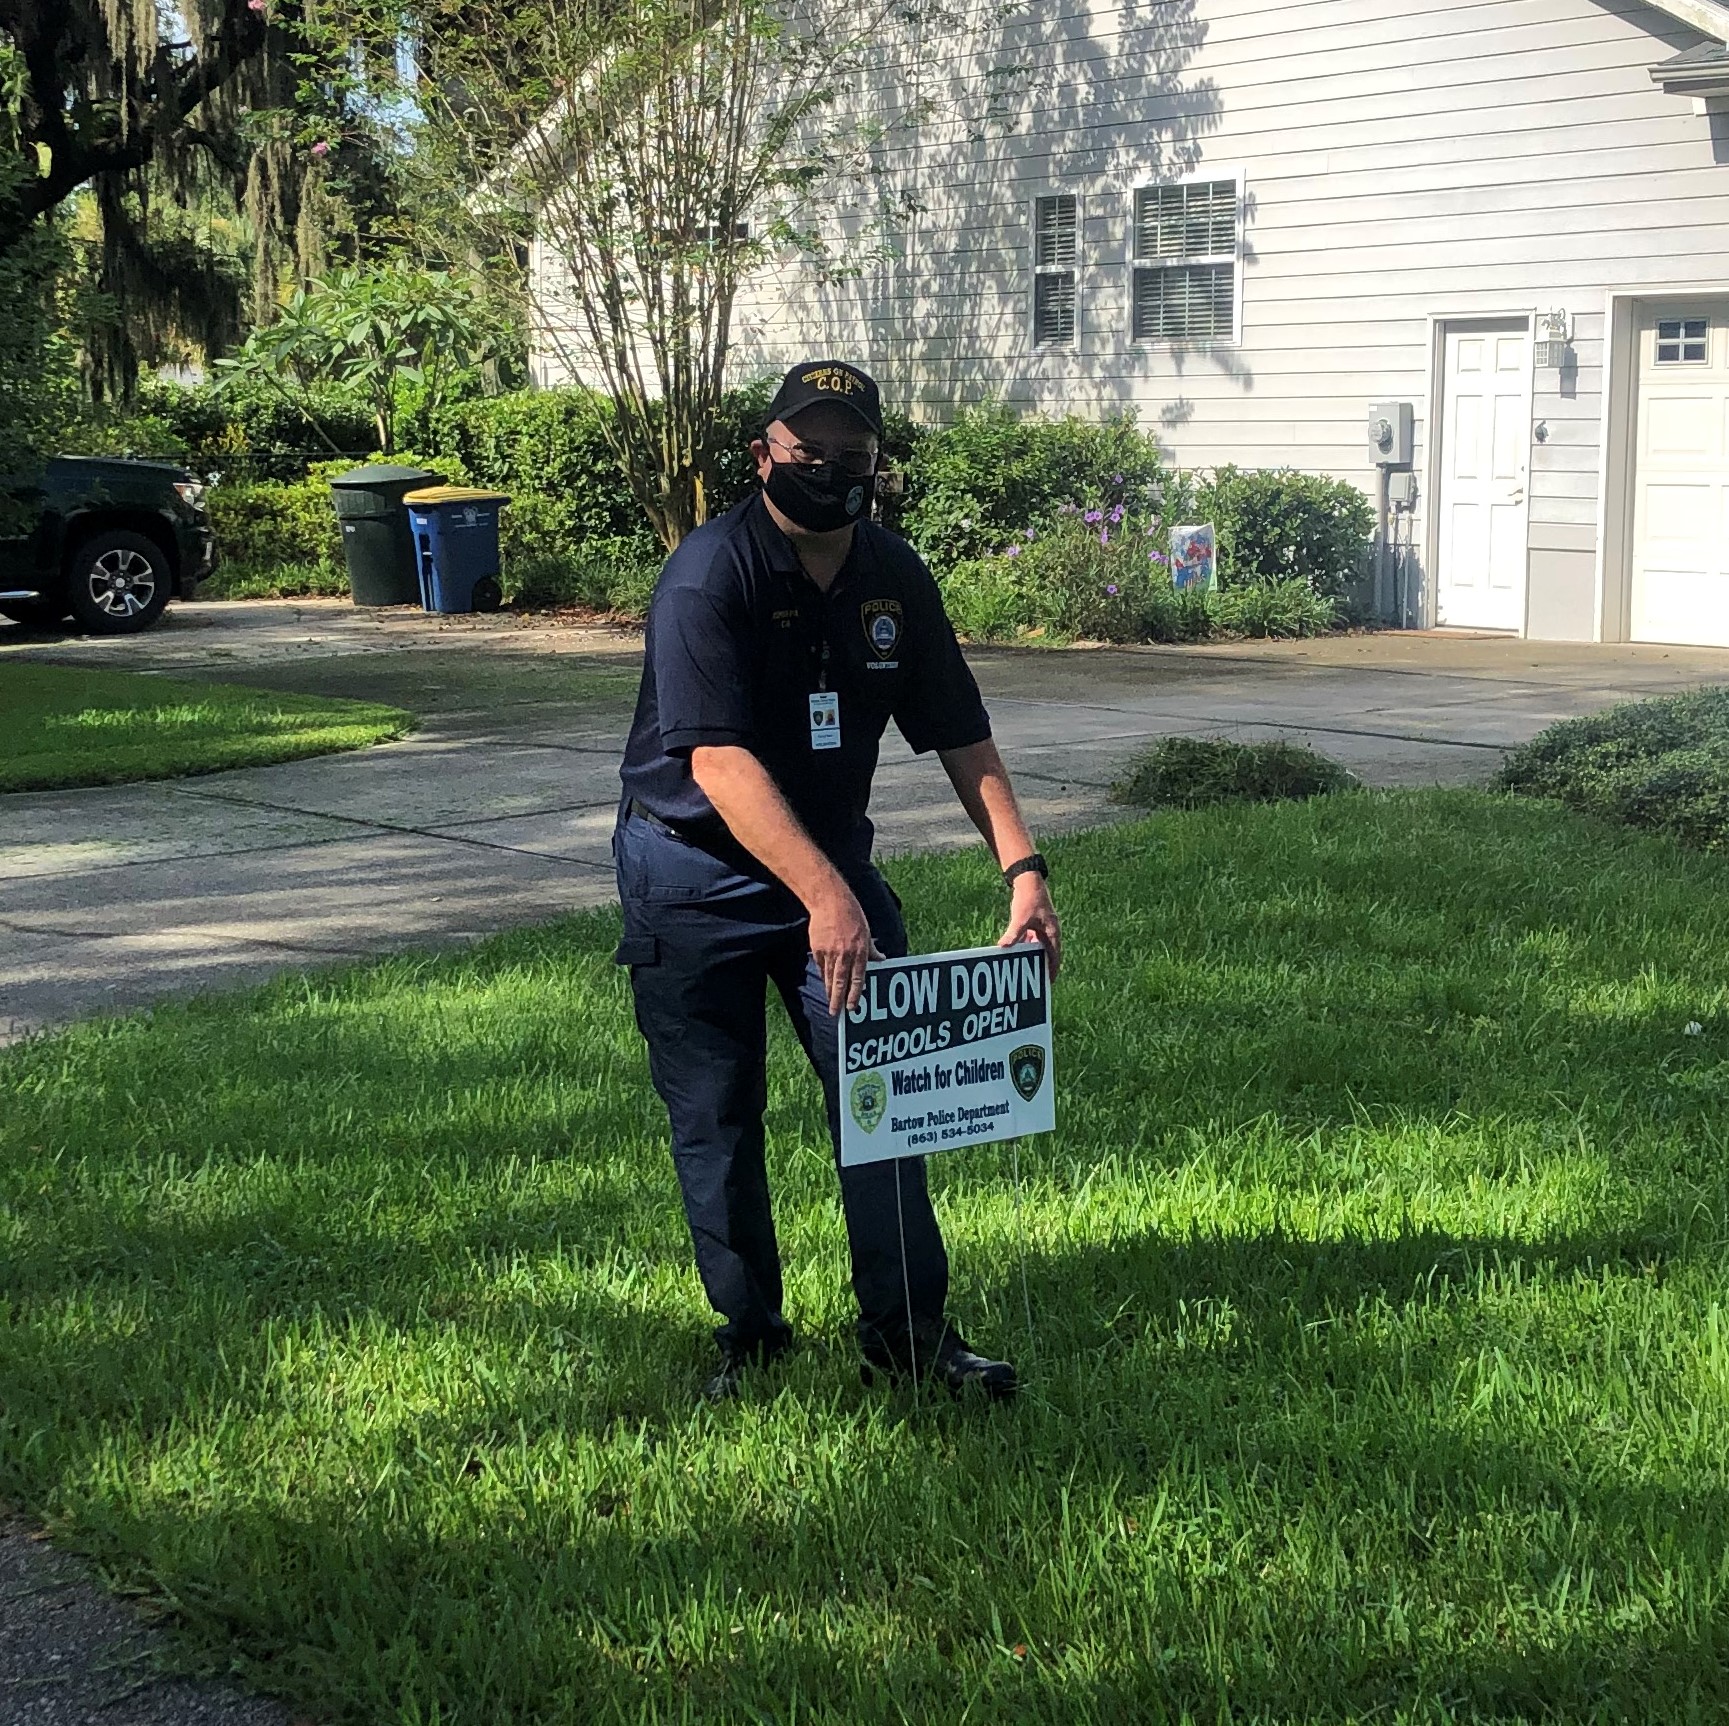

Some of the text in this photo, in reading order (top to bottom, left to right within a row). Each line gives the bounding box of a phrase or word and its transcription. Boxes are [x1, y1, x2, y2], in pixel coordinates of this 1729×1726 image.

[865, 602, 902, 615] POLICE
[951, 955, 1041, 1010] DOWN
[847, 1003, 1019, 1070] SCHOOLS OPEN
[1012, 1048, 1042, 1063] POLICE
[891, 1058, 1005, 1096] Watch for Children
[891, 1100, 1010, 1132] Bartow Police Department
[907, 1121, 995, 1148] (863) 534-5034
